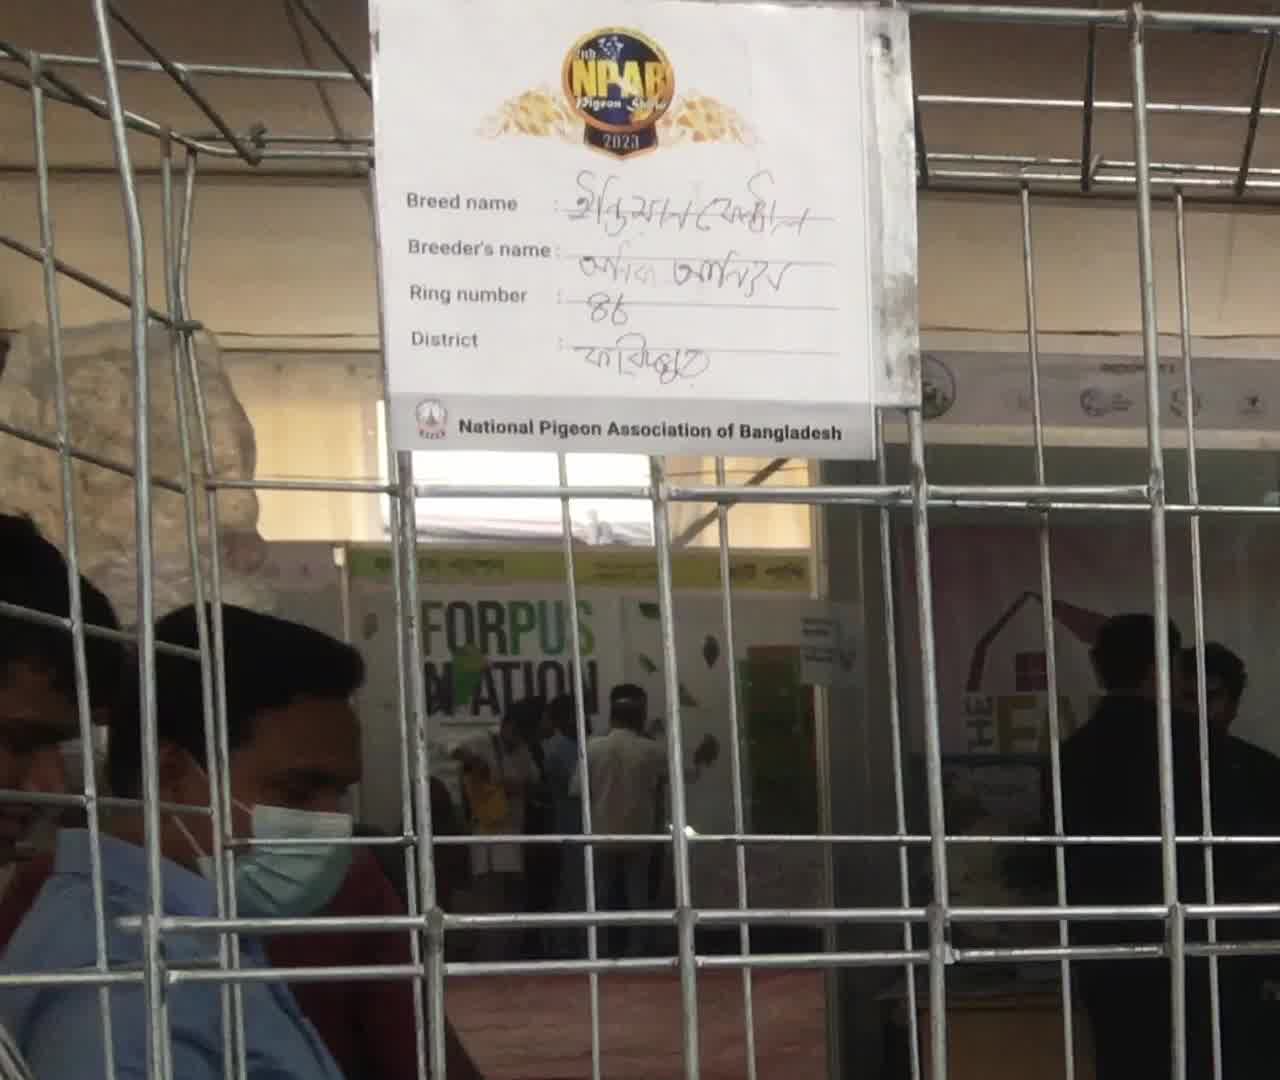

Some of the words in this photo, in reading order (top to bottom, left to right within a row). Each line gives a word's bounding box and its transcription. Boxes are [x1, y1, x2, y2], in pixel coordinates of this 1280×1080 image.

[571, 60, 672, 98] NPAB
[602, 133, 640, 150] 2023
[405, 191, 461, 209] Breed
[465, 197, 519, 212] name
[407, 238, 494, 256] Breeder's
[499, 244, 552, 258] name
[409, 283, 452, 307] Ring
[456, 286, 529, 304] number
[410, 330, 479, 348] District
[458, 418, 534, 437] National
[538, 419, 602, 440] Pigeon
[607, 421, 714, 439] Association
[716, 422, 735, 440] of
[739, 423, 843, 443] Bangladesh
[420, 599, 595, 655] FORPUS
[423, 659, 599, 716] NATION
